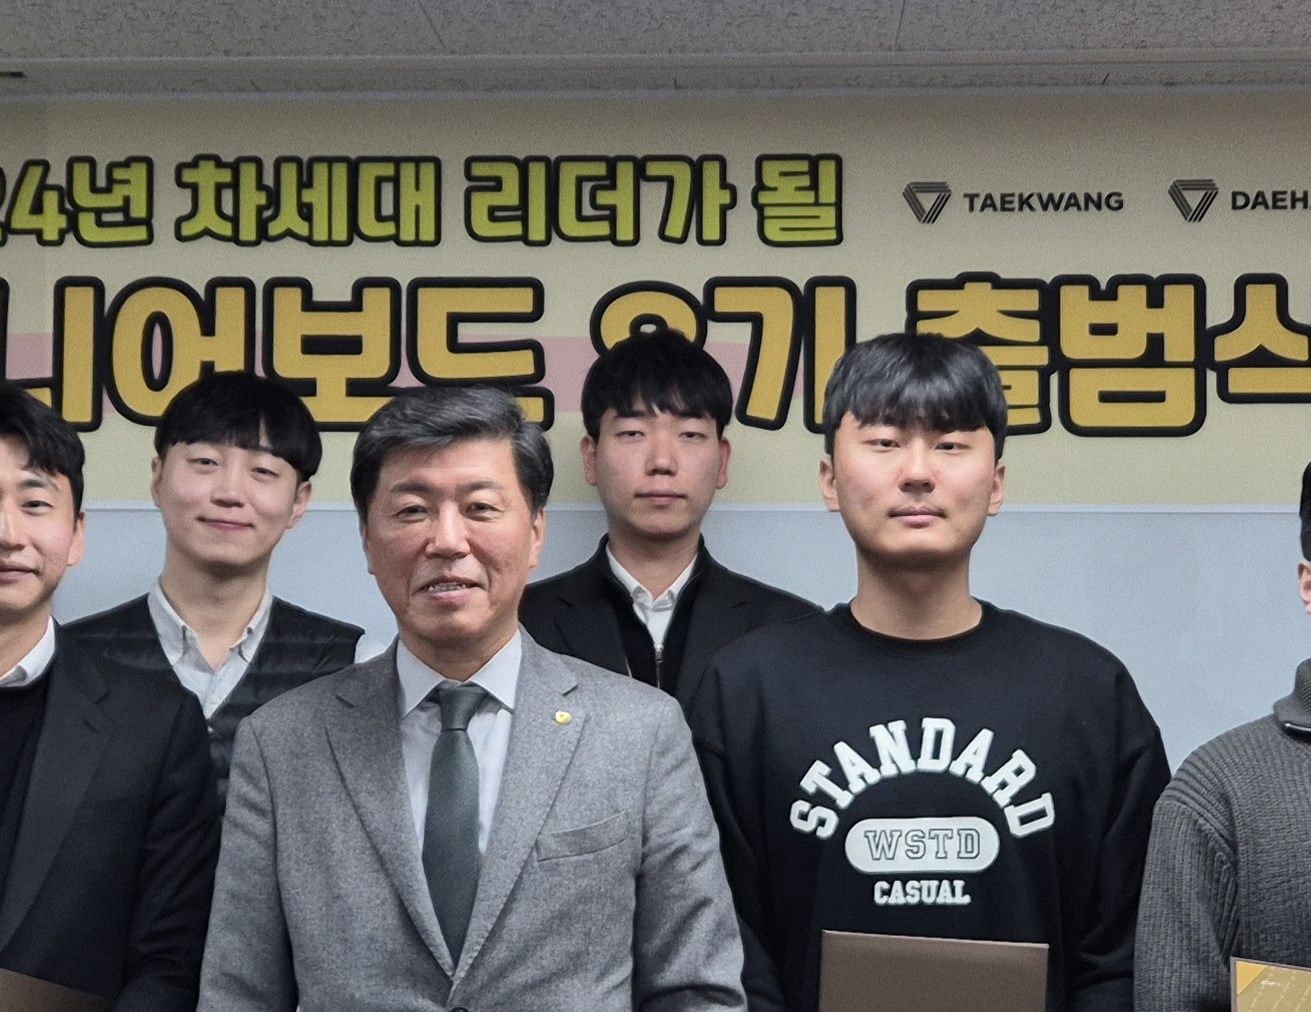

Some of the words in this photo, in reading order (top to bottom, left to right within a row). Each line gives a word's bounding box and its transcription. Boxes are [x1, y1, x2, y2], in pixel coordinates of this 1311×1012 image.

[176, 154, 441, 246] 차세대
[465, 154, 735, 246] 리더가
[751, 153, 844, 245] 될
[963, 190, 1125, 213] TAEKWANG
[789, 717, 1056, 840] STANDARD
[865, 828, 981, 860] WSTD
[874, 879, 971, 905] CASUAL
